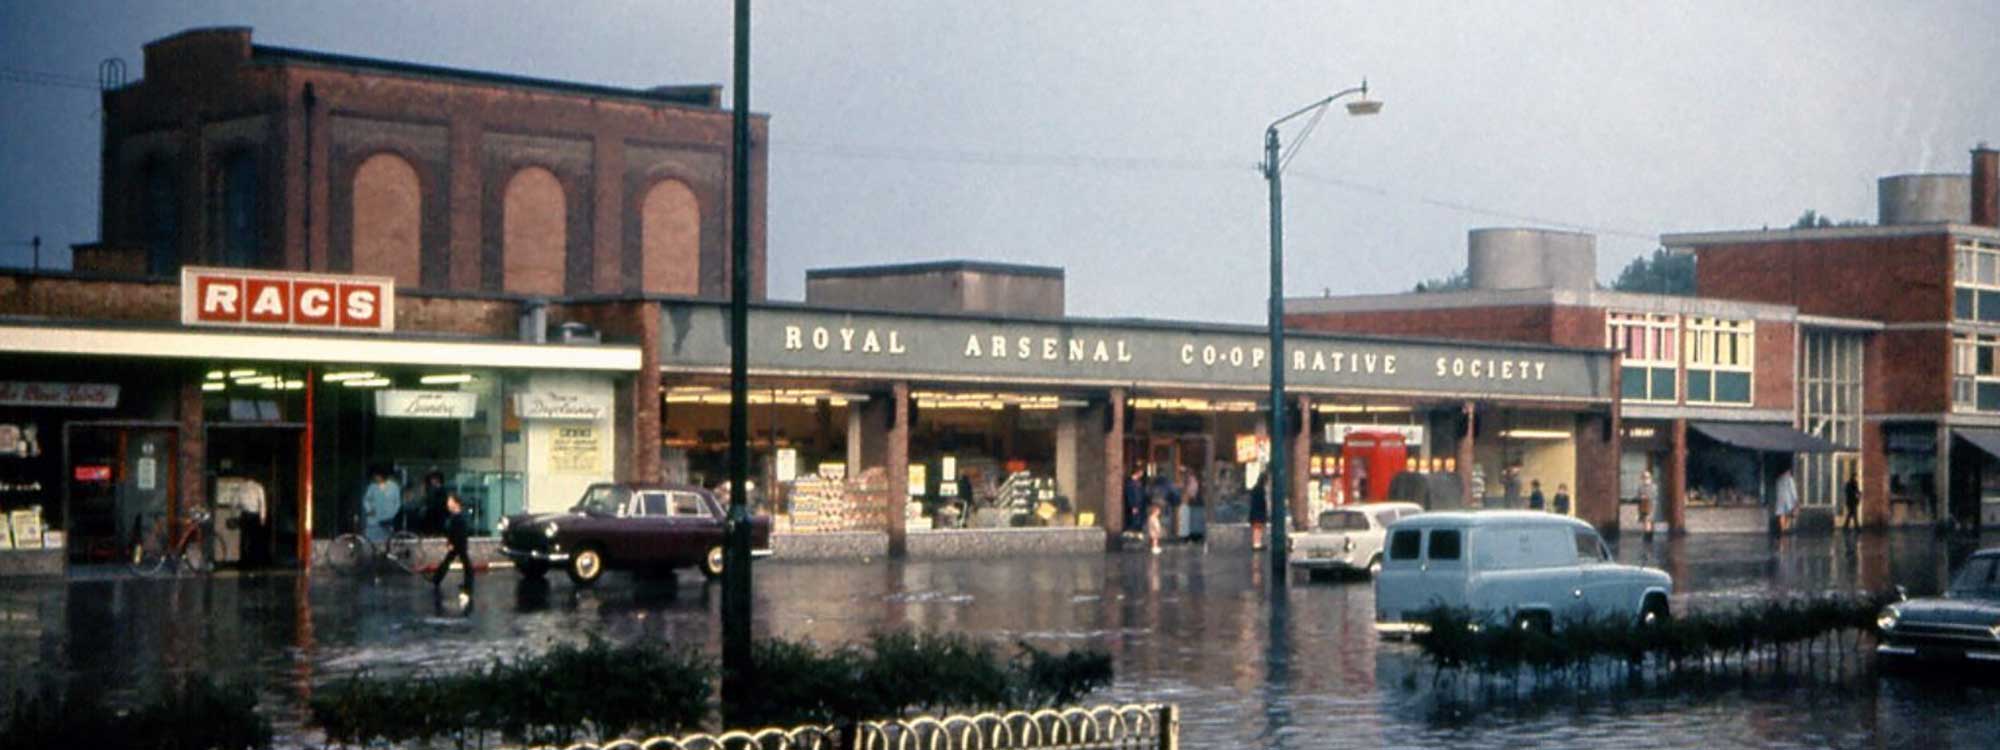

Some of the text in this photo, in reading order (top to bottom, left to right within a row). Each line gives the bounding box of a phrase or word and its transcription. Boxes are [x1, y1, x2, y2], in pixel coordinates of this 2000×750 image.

[203, 283, 375, 320] RACS
[785, 325, 905, 353] ROYAL
[964, 334, 1132, 362] ARSENAL
[1435, 357, 1545, 380] SOCIETY
